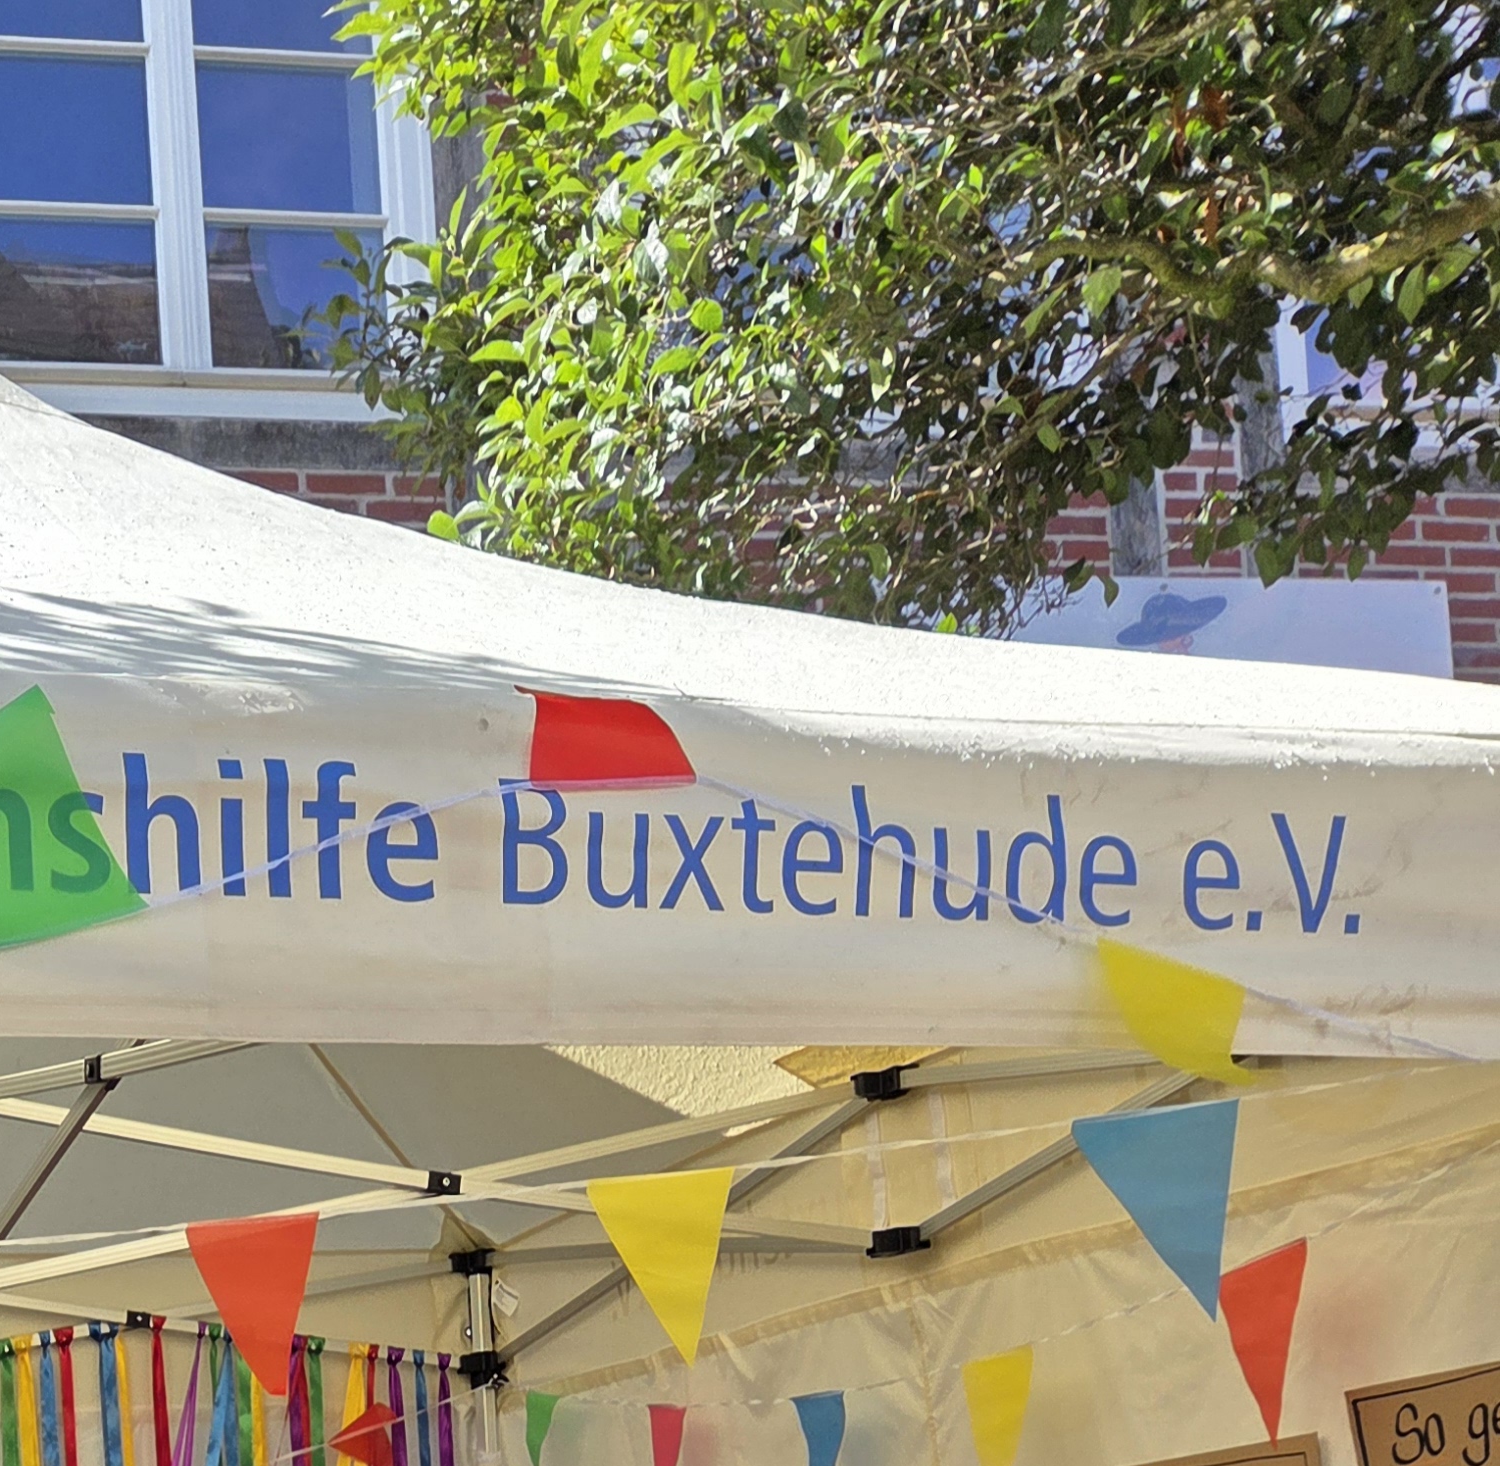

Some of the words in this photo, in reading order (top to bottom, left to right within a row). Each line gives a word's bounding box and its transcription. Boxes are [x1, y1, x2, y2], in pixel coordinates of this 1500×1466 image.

[499, 778, 1138, 927] Buxtehude
[1182, 812, 1362, 934] e.V.
[1391, 1402, 1445, 1465] So
